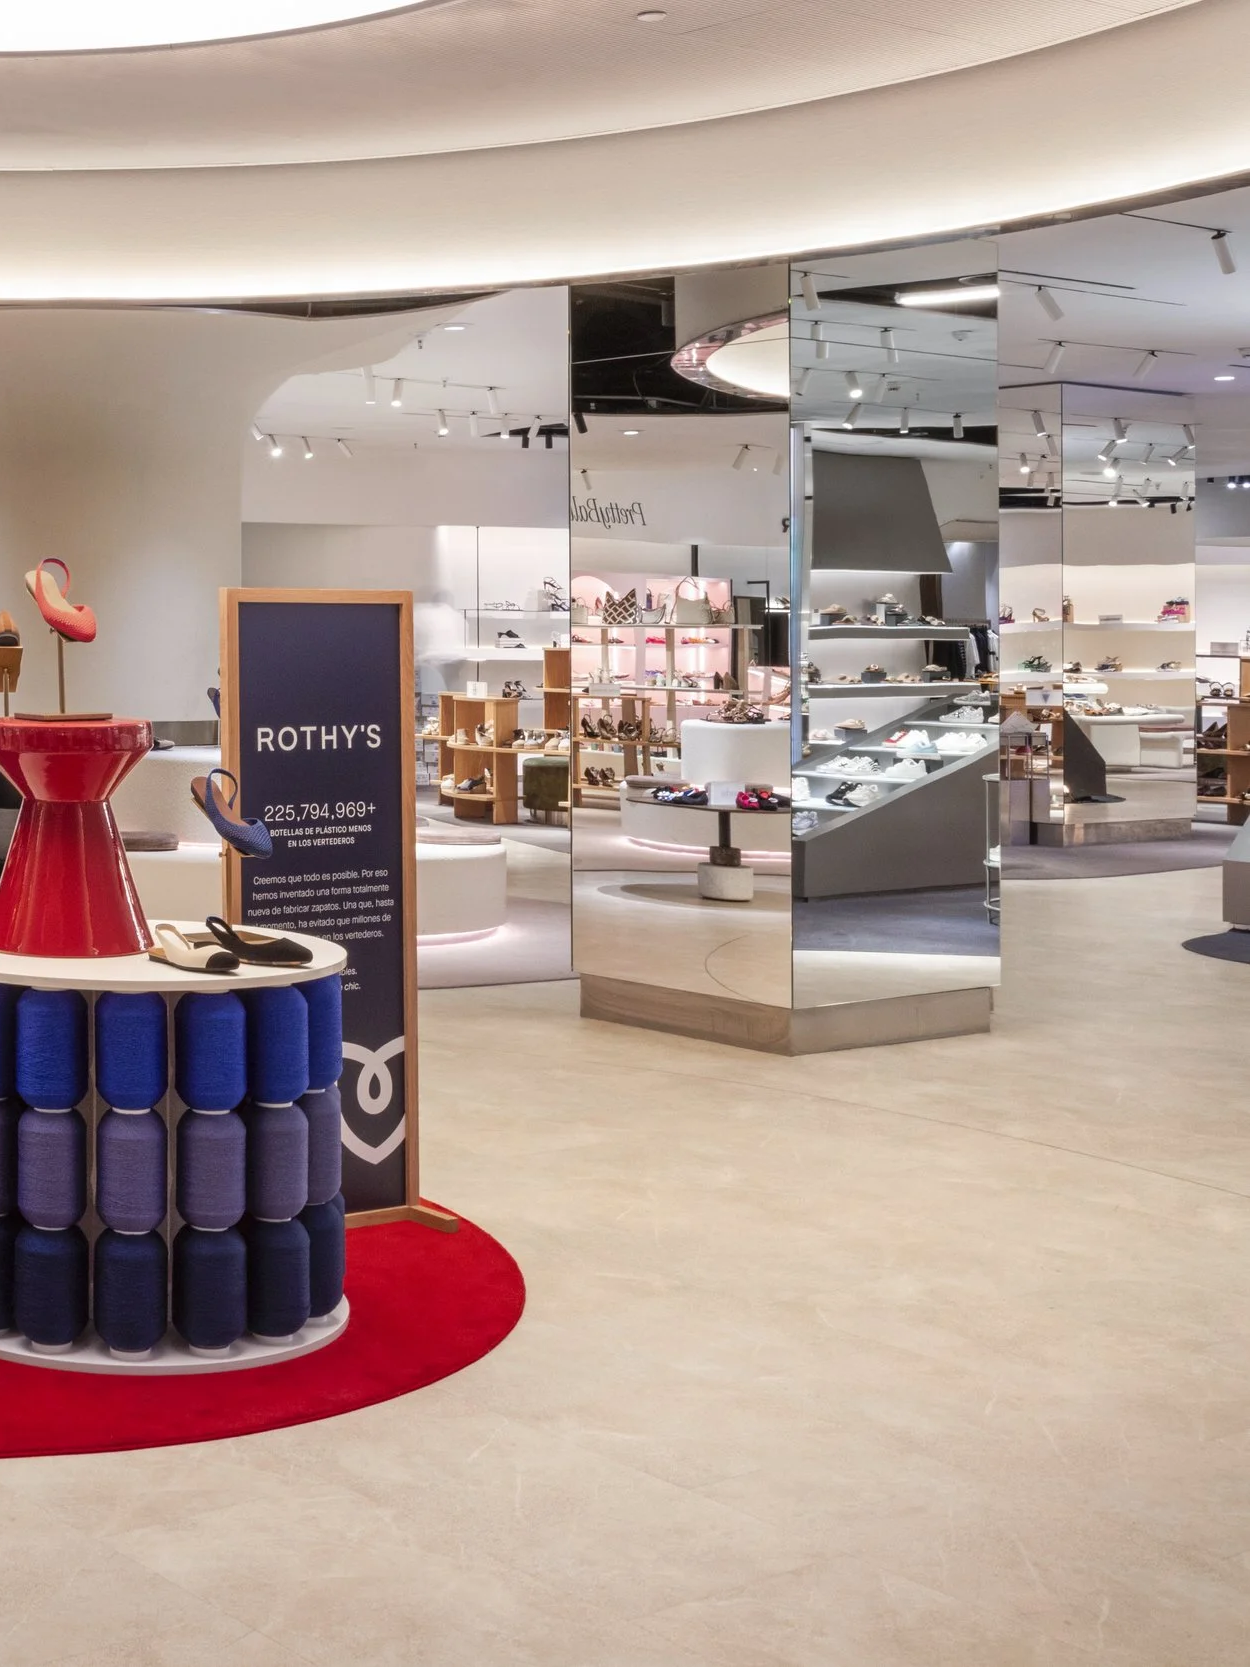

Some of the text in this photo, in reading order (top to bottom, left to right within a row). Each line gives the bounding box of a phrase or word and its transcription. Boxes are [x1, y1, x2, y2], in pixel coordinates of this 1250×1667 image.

[257, 724, 381, 752] ROTHY'S
[264, 801, 376, 822] 225,794,969+
[270, 824, 372, 837] BOTELLAS DE PLÁSTICO MENOS
[288, 837, 355, 848] EN LOS VERTEDEROS
[253, 869, 388, 885] Creemos que todo es posible. Por eso
[252, 884, 389, 900] hemos inventado una forma totalmente
[247, 898, 395, 917] nueva de fabricar zapatos. Una que, hasta
[298, 920, 308, 928] ha
[309, 917, 335, 927] evitado
[336, 918, 350, 927] que
[352, 915, 380, 924] millones
[381, 913, 392, 922] de
[332, 932, 343, 941] los
[345, 930, 384, 940] vertederos.
[344, 982, 361, 991] chic.
